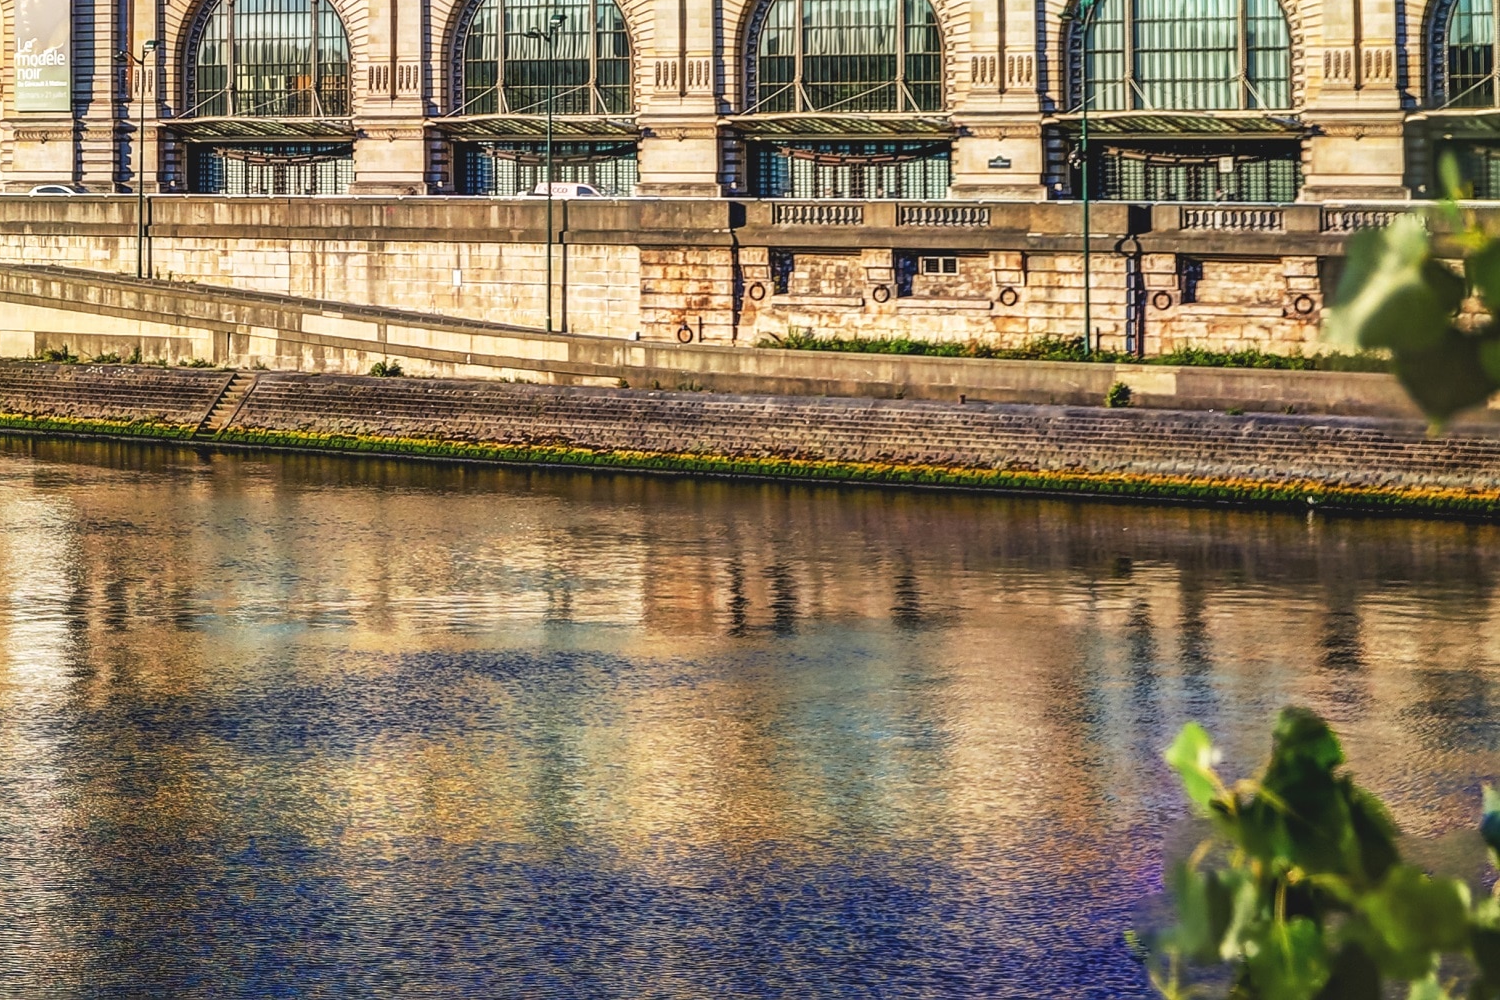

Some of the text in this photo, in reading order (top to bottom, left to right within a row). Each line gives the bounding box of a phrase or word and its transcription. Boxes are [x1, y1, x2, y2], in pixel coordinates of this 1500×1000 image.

[17, 37, 37, 53] Le
[17, 68, 42, 80] noir
[543, 186, 568, 194] SCCO
